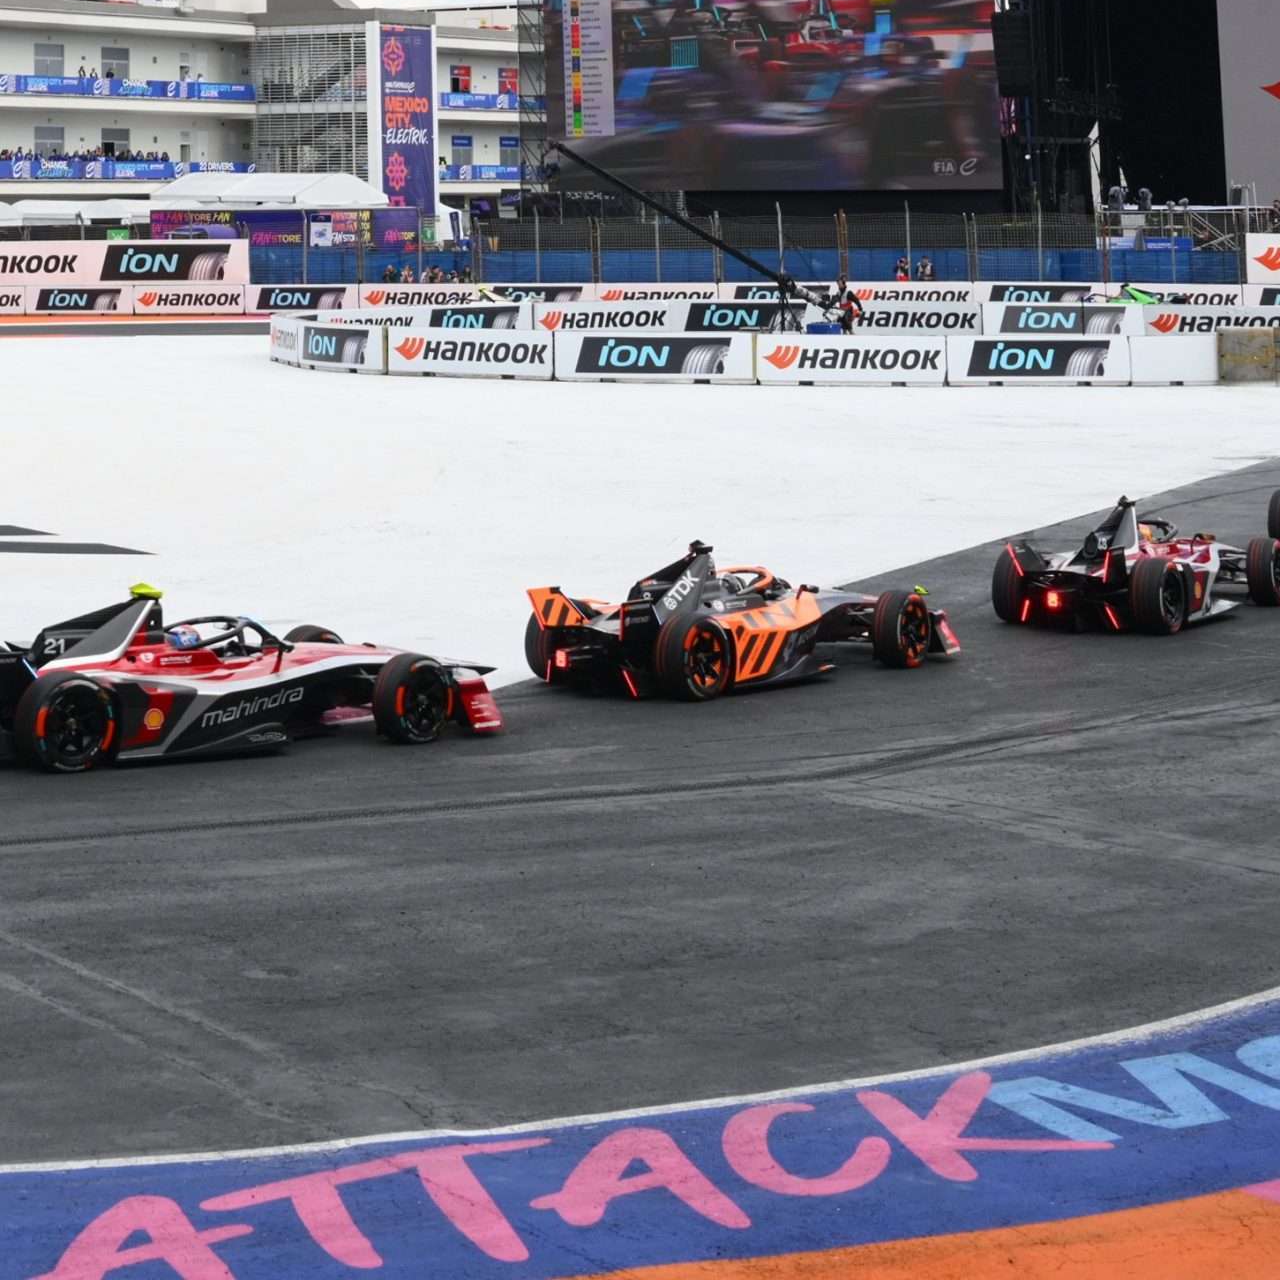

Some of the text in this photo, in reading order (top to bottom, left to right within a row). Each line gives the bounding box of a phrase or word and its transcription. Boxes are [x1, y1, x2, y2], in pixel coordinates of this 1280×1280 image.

[384, 96, 429, 112] MEXICO
[119, 248, 178, 273] iON
[48, 289, 88, 307] iON
[157, 292, 241, 307] HanKOOK
[269, 288, 311, 306] iON
[561, 310, 667, 329] HanKOOK
[703, 304, 759, 326] iON
[1018, 307, 1077, 329] iON
[307, 329, 337, 356] iON
[423, 340, 548, 364] HanKOOK
[598, 339, 670, 367] iON
[798, 349, 941, 370] HanKOOK
[988, 342, 1055, 370] iON
[668, 569, 700, 601] TDK
[43, 638, 66, 654] 21
[201, 686, 304, 728] mahindra
[25, 1071, 1115, 1280] ATTACK
